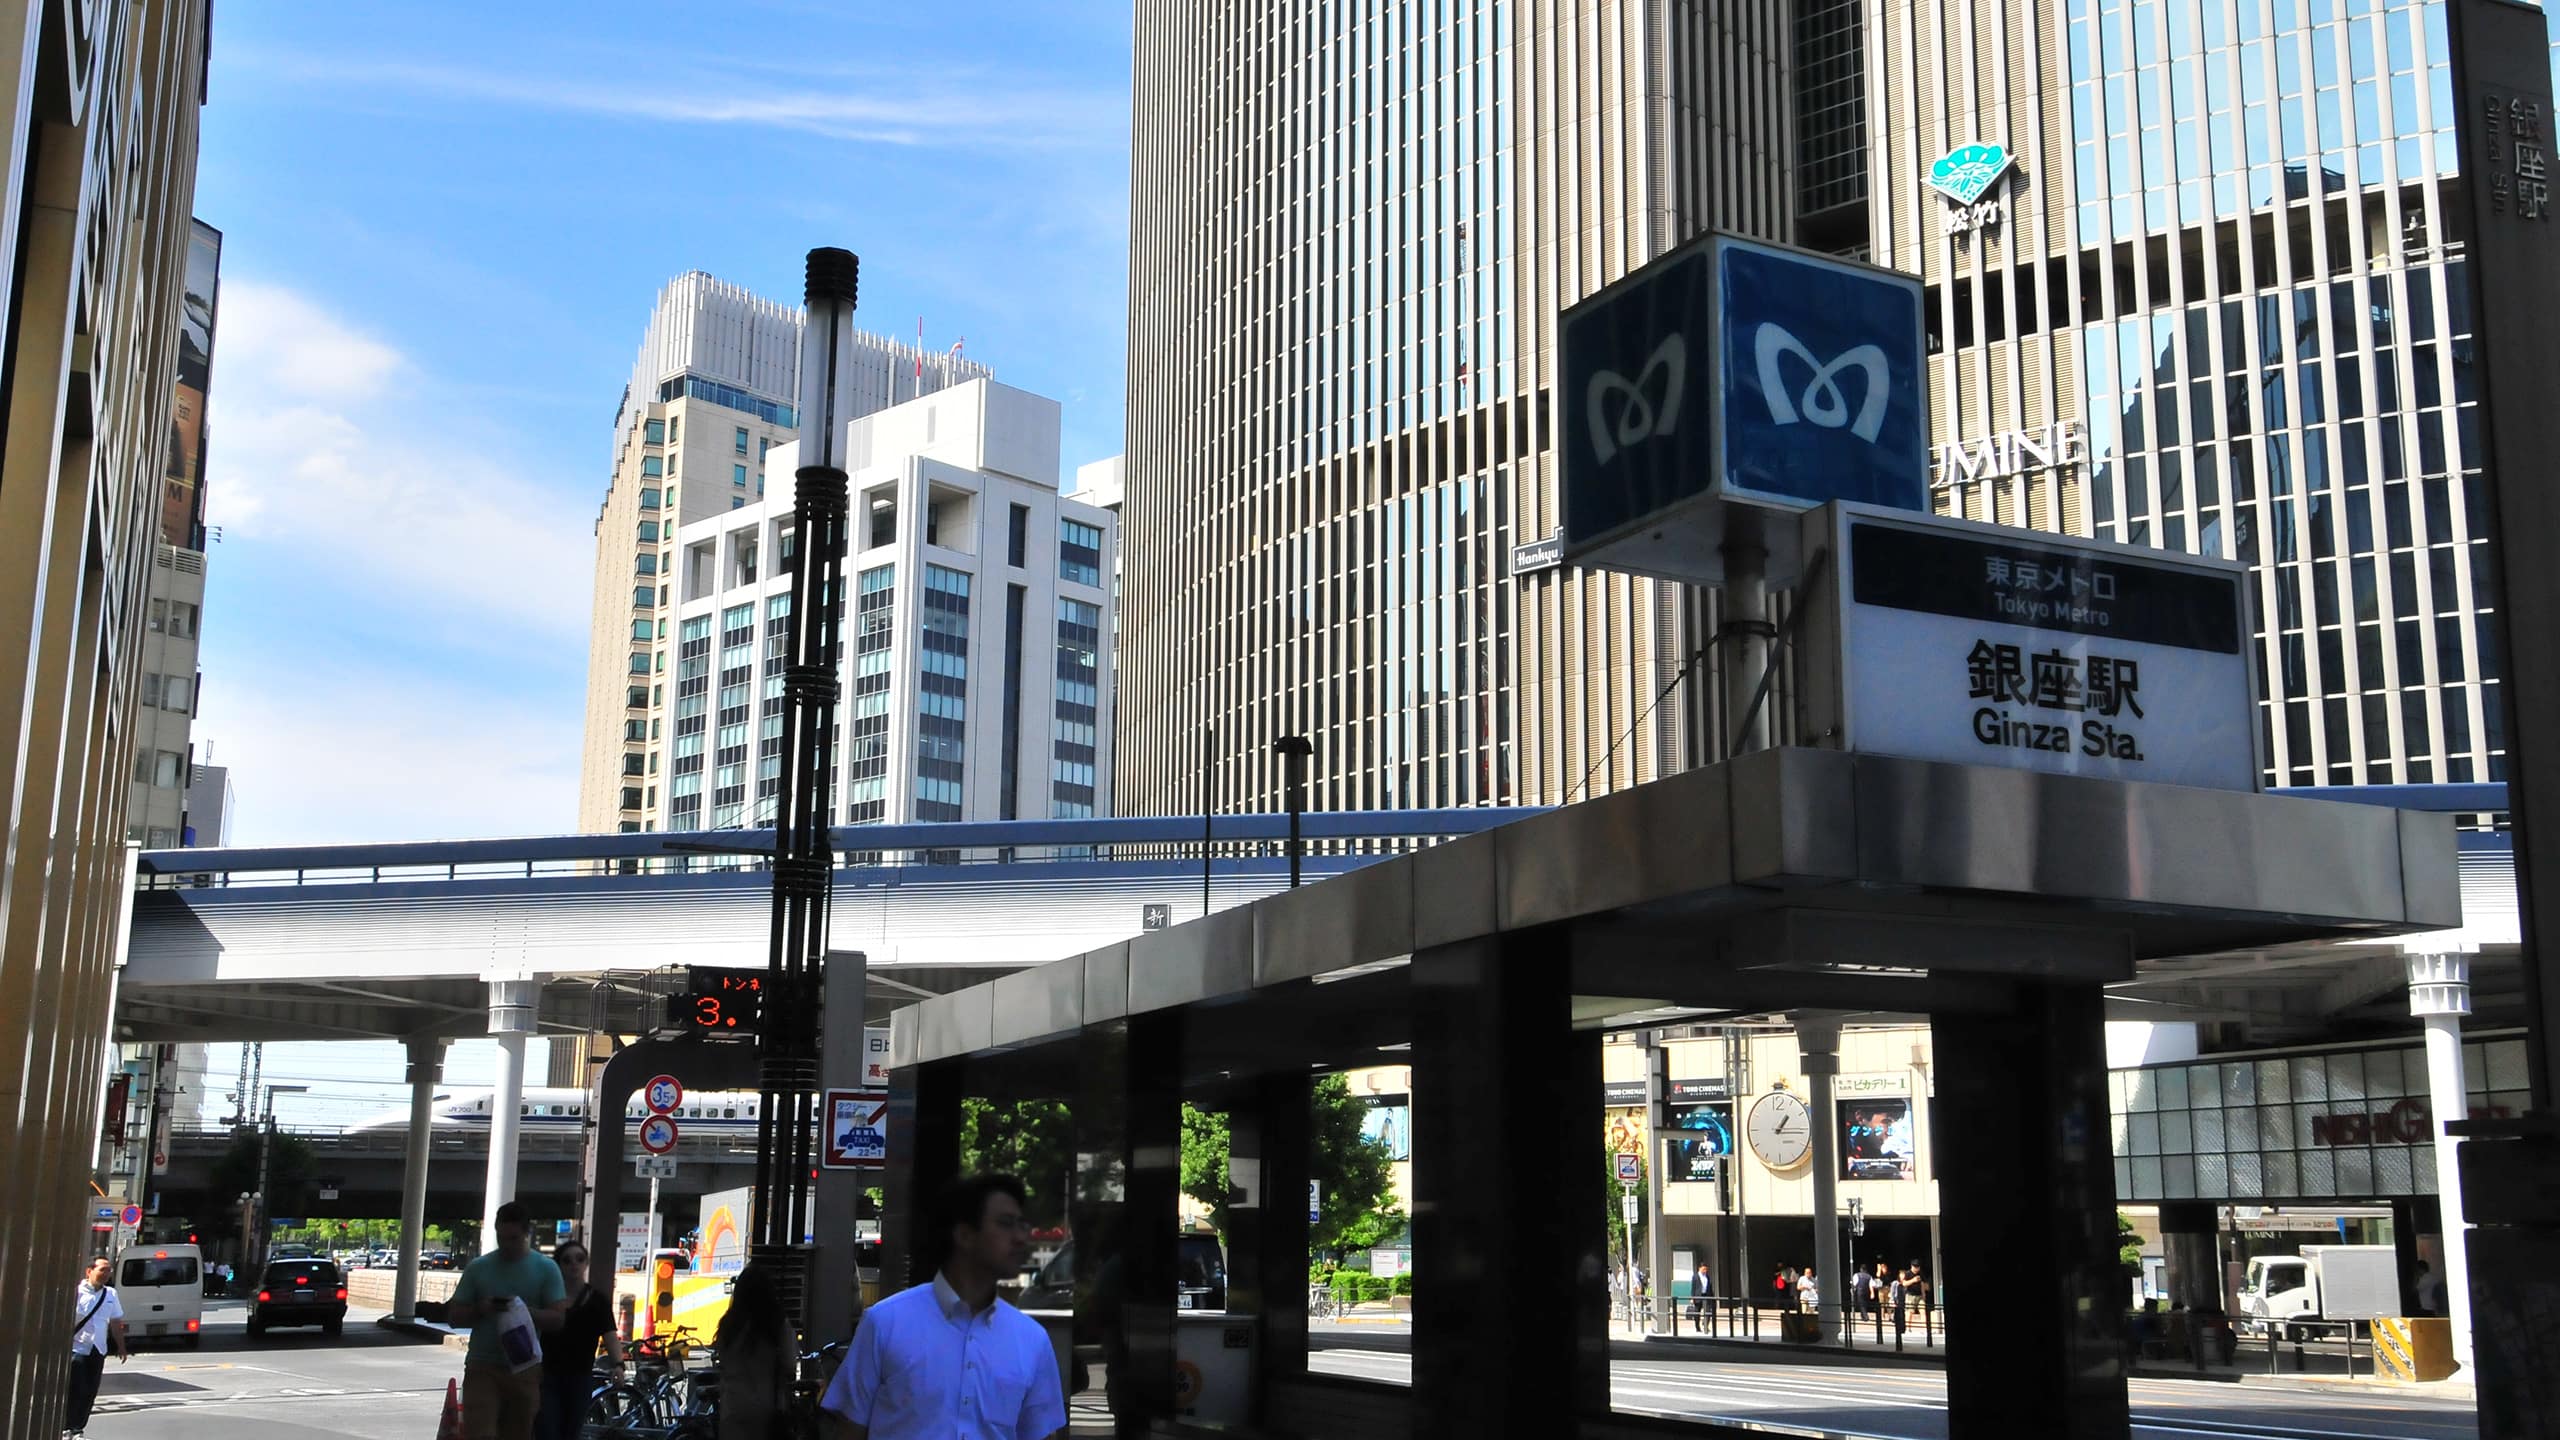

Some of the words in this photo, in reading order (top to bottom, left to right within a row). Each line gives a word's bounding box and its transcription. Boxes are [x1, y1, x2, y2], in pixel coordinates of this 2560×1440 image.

[2510, 98, 2549, 223] 銀座駅
[1946, 200, 1998, 234] 松竹
[1516, 547, 1559, 566] Hankyu
[1985, 555, 2115, 600] 東京メトロ
[1995, 591, 2049, 619] Tokyo
[2055, 602, 2109, 627] Metro
[1966, 638, 2144, 720] 銀座駅
[1973, 707, 2070, 753] Ginza
[2081, 719, 2144, 762] Sta.
